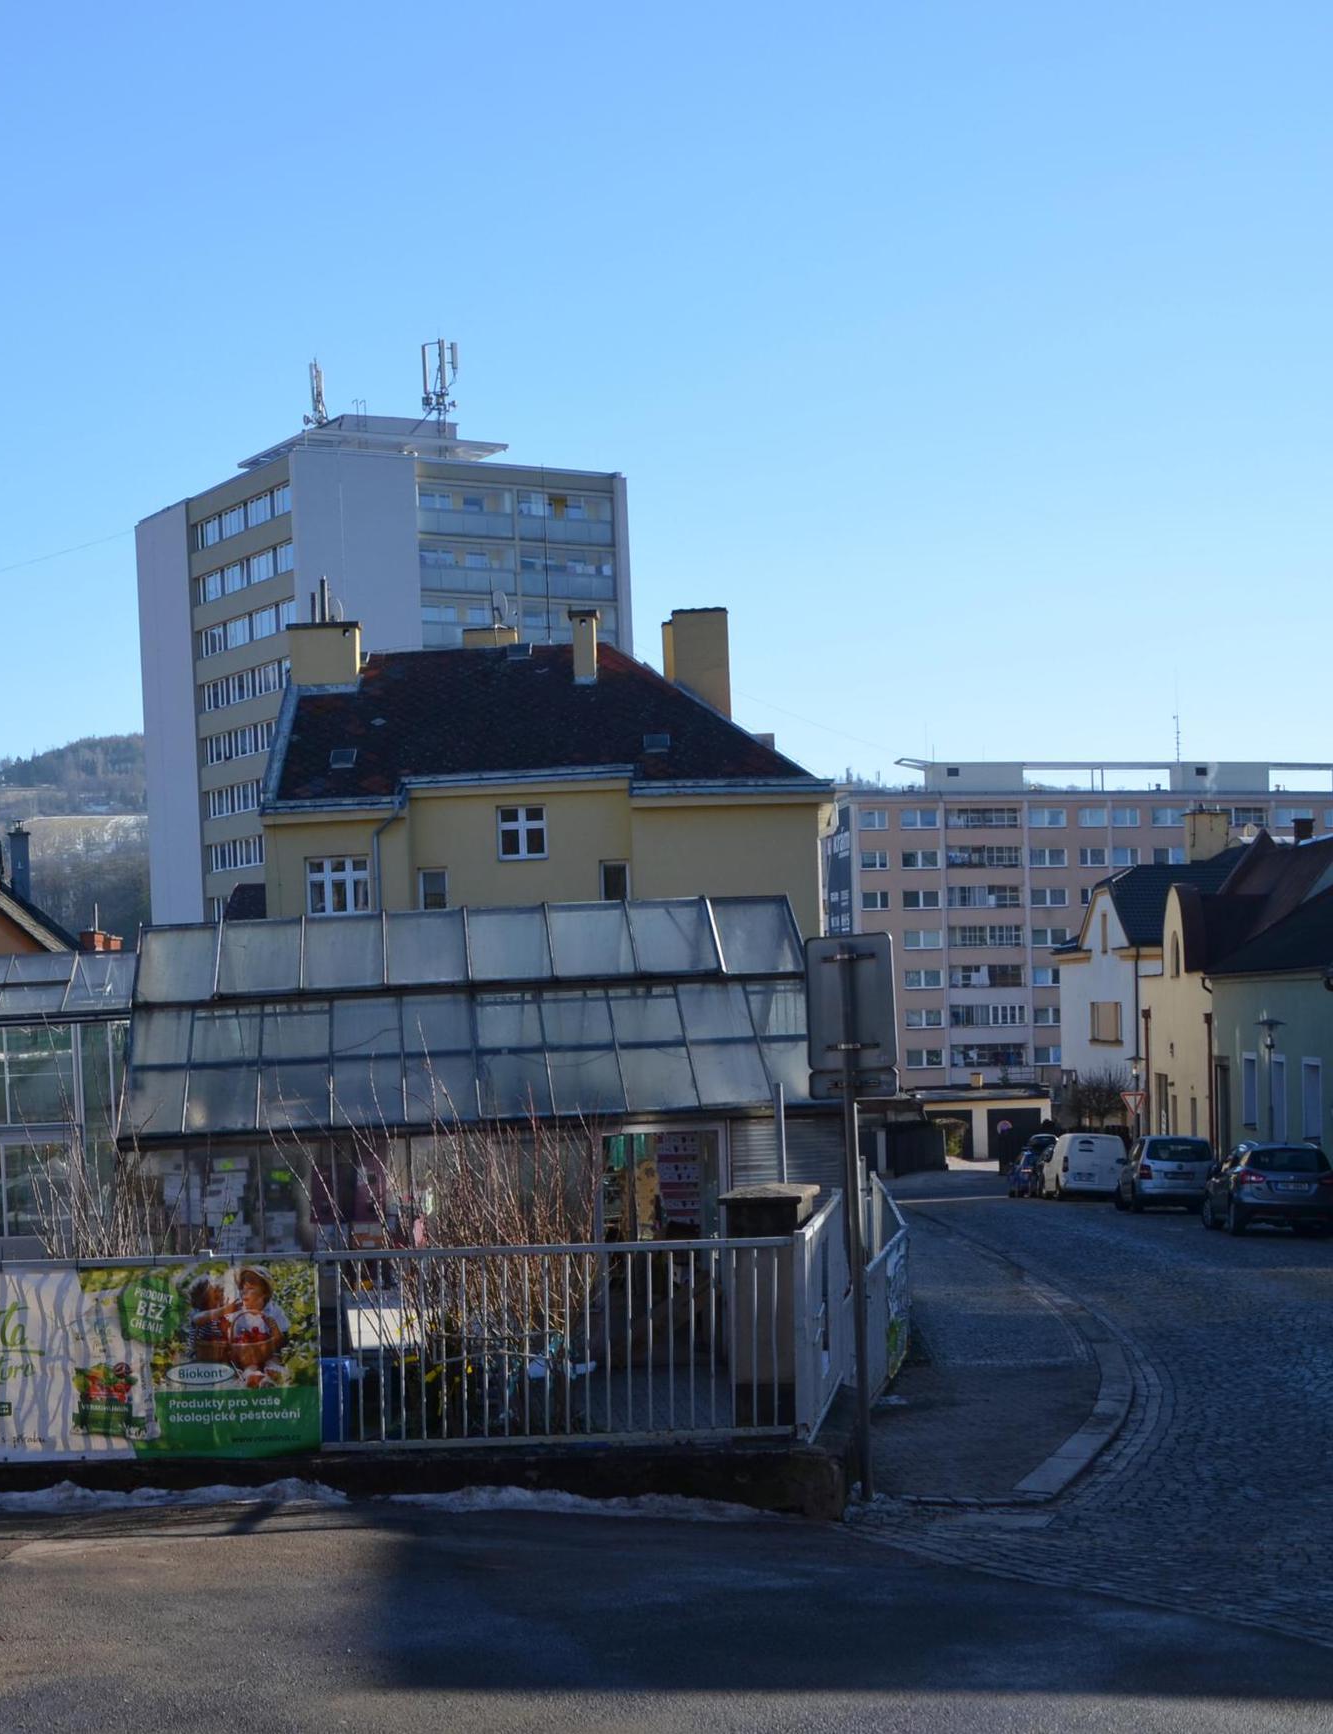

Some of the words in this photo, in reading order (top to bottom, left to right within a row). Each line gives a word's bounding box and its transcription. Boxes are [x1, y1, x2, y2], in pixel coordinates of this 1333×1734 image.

[134, 1287, 173, 1304] PRODUKT
[136, 1300, 166, 1321] BEZ
[130, 1318, 164, 1334] CHEMIE
[178, 1368, 224, 1379] Biokont
[169, 1398, 223, 1410] Produkty
[228, 1398, 248, 1409] pro
[252, 1395, 281, 1406] vaše
[169, 1411, 237, 1424] ekologické
[240, 1408, 301, 1422] pěstování
